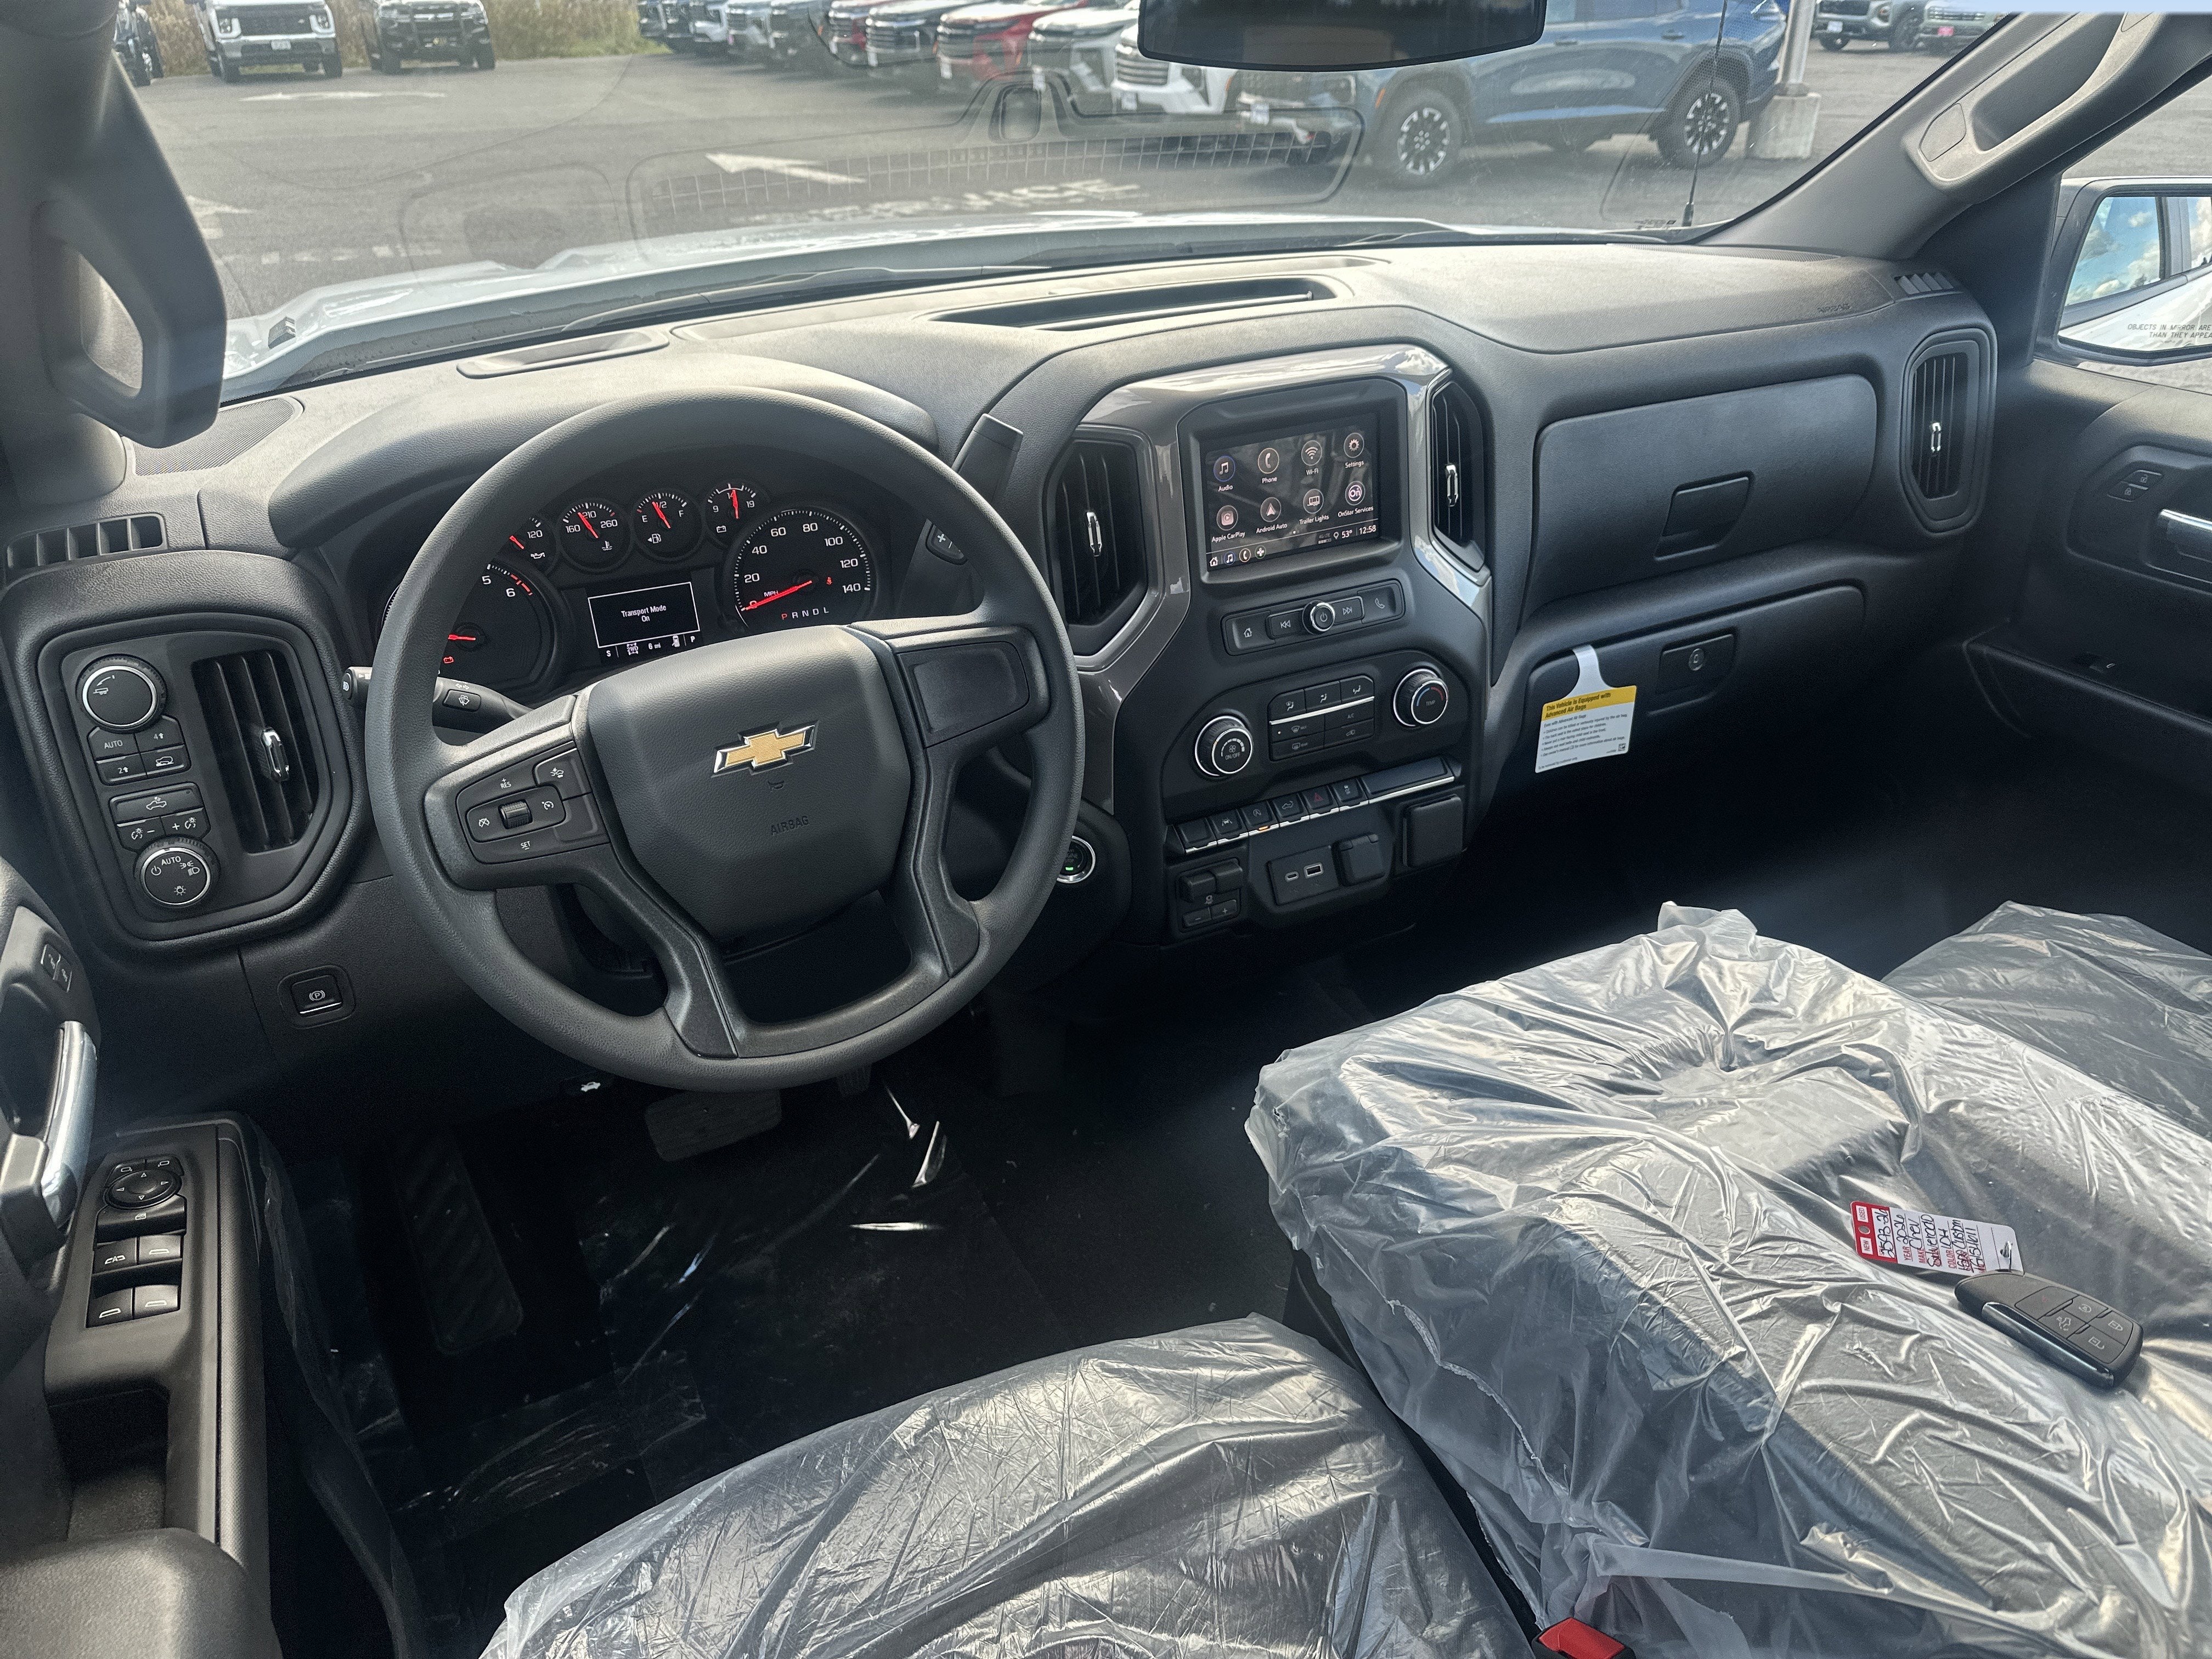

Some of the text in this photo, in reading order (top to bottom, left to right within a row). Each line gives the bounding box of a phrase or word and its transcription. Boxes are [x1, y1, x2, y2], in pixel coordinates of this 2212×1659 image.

[1345, 460, 1364, 469] Settings
[583, 510, 597, 519] 210
[1338, 509, 1354, 517] OnStar
[600, 519, 618, 528] 260
[1314, 515, 1329, 523] Lights
[565, 524, 580, 533] 160
[770, 527, 786, 537] 60
[803, 522, 818, 533] 80
[1256, 524, 1275, 534] Android
[1359, 525, 1376, 534] 12:58
[527, 529, 543, 539] 120
[1211, 531, 1245, 543] Apple CarPlay
[824, 536, 843, 546] 100
[752, 545, 768, 555] 40
[840, 558, 859, 568] 120
[482, 575, 492, 585] 5
[744, 573, 760, 583] 20
[506, 588, 516, 597] 6
[842, 583, 861, 594] 140
[621, 605, 667, 618] Transport Mode
[1556, 700, 1572, 709] Vehicle
[1578, 694, 1600, 703] Equipped
[1545, 708, 1566, 719] Advanced
[104, 740, 123, 749] AUTO
[1225, 752, 1240, 760] ON/OFF
[500, 781, 512, 789] RES
[771, 816, 809, 836] AIRBAG
[521, 840, 531, 849] SET
[161, 856, 182, 866] AUTO
[1894, 1215, 1909, 1245] 2026
[1946, 1250, 1957, 1269] COLOR
